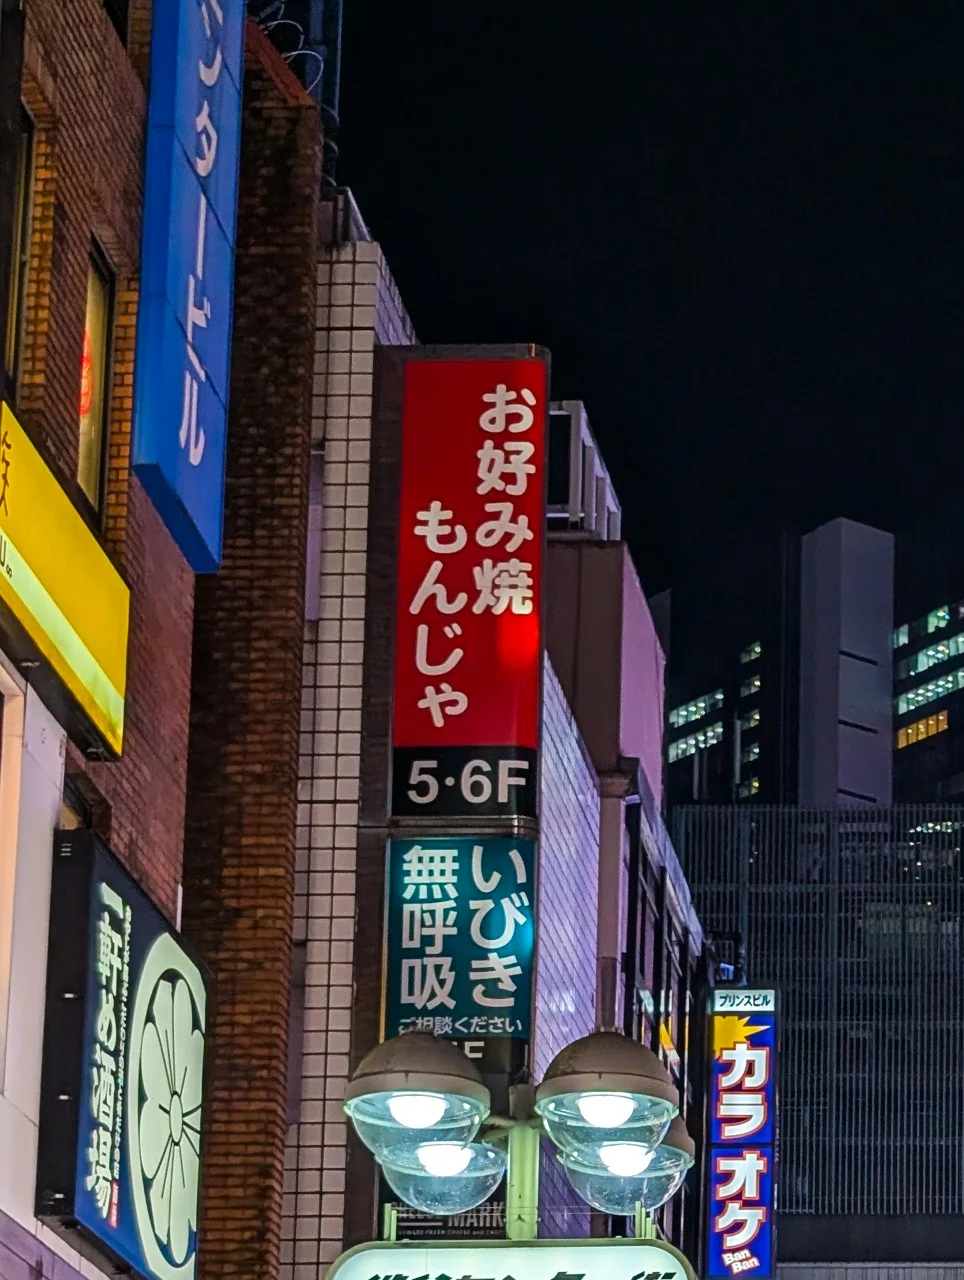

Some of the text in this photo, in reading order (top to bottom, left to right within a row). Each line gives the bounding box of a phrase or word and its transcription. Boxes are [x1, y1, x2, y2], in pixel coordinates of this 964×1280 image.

[179, 0, 223, 466] ンタービル
[471, 383, 537, 615] お好み焼
[407, 500, 470, 728] もんじゃ
[400, 845, 460, 1010] 無呼吸
[469, 844, 528, 1008] いびき
[718, 994, 771, 1008] プリンスビル
[714, 1041, 771, 1251] カラオケ
[722, 1249, 750, 1267] Ban
[731, 1256, 760, 1275] Ban
